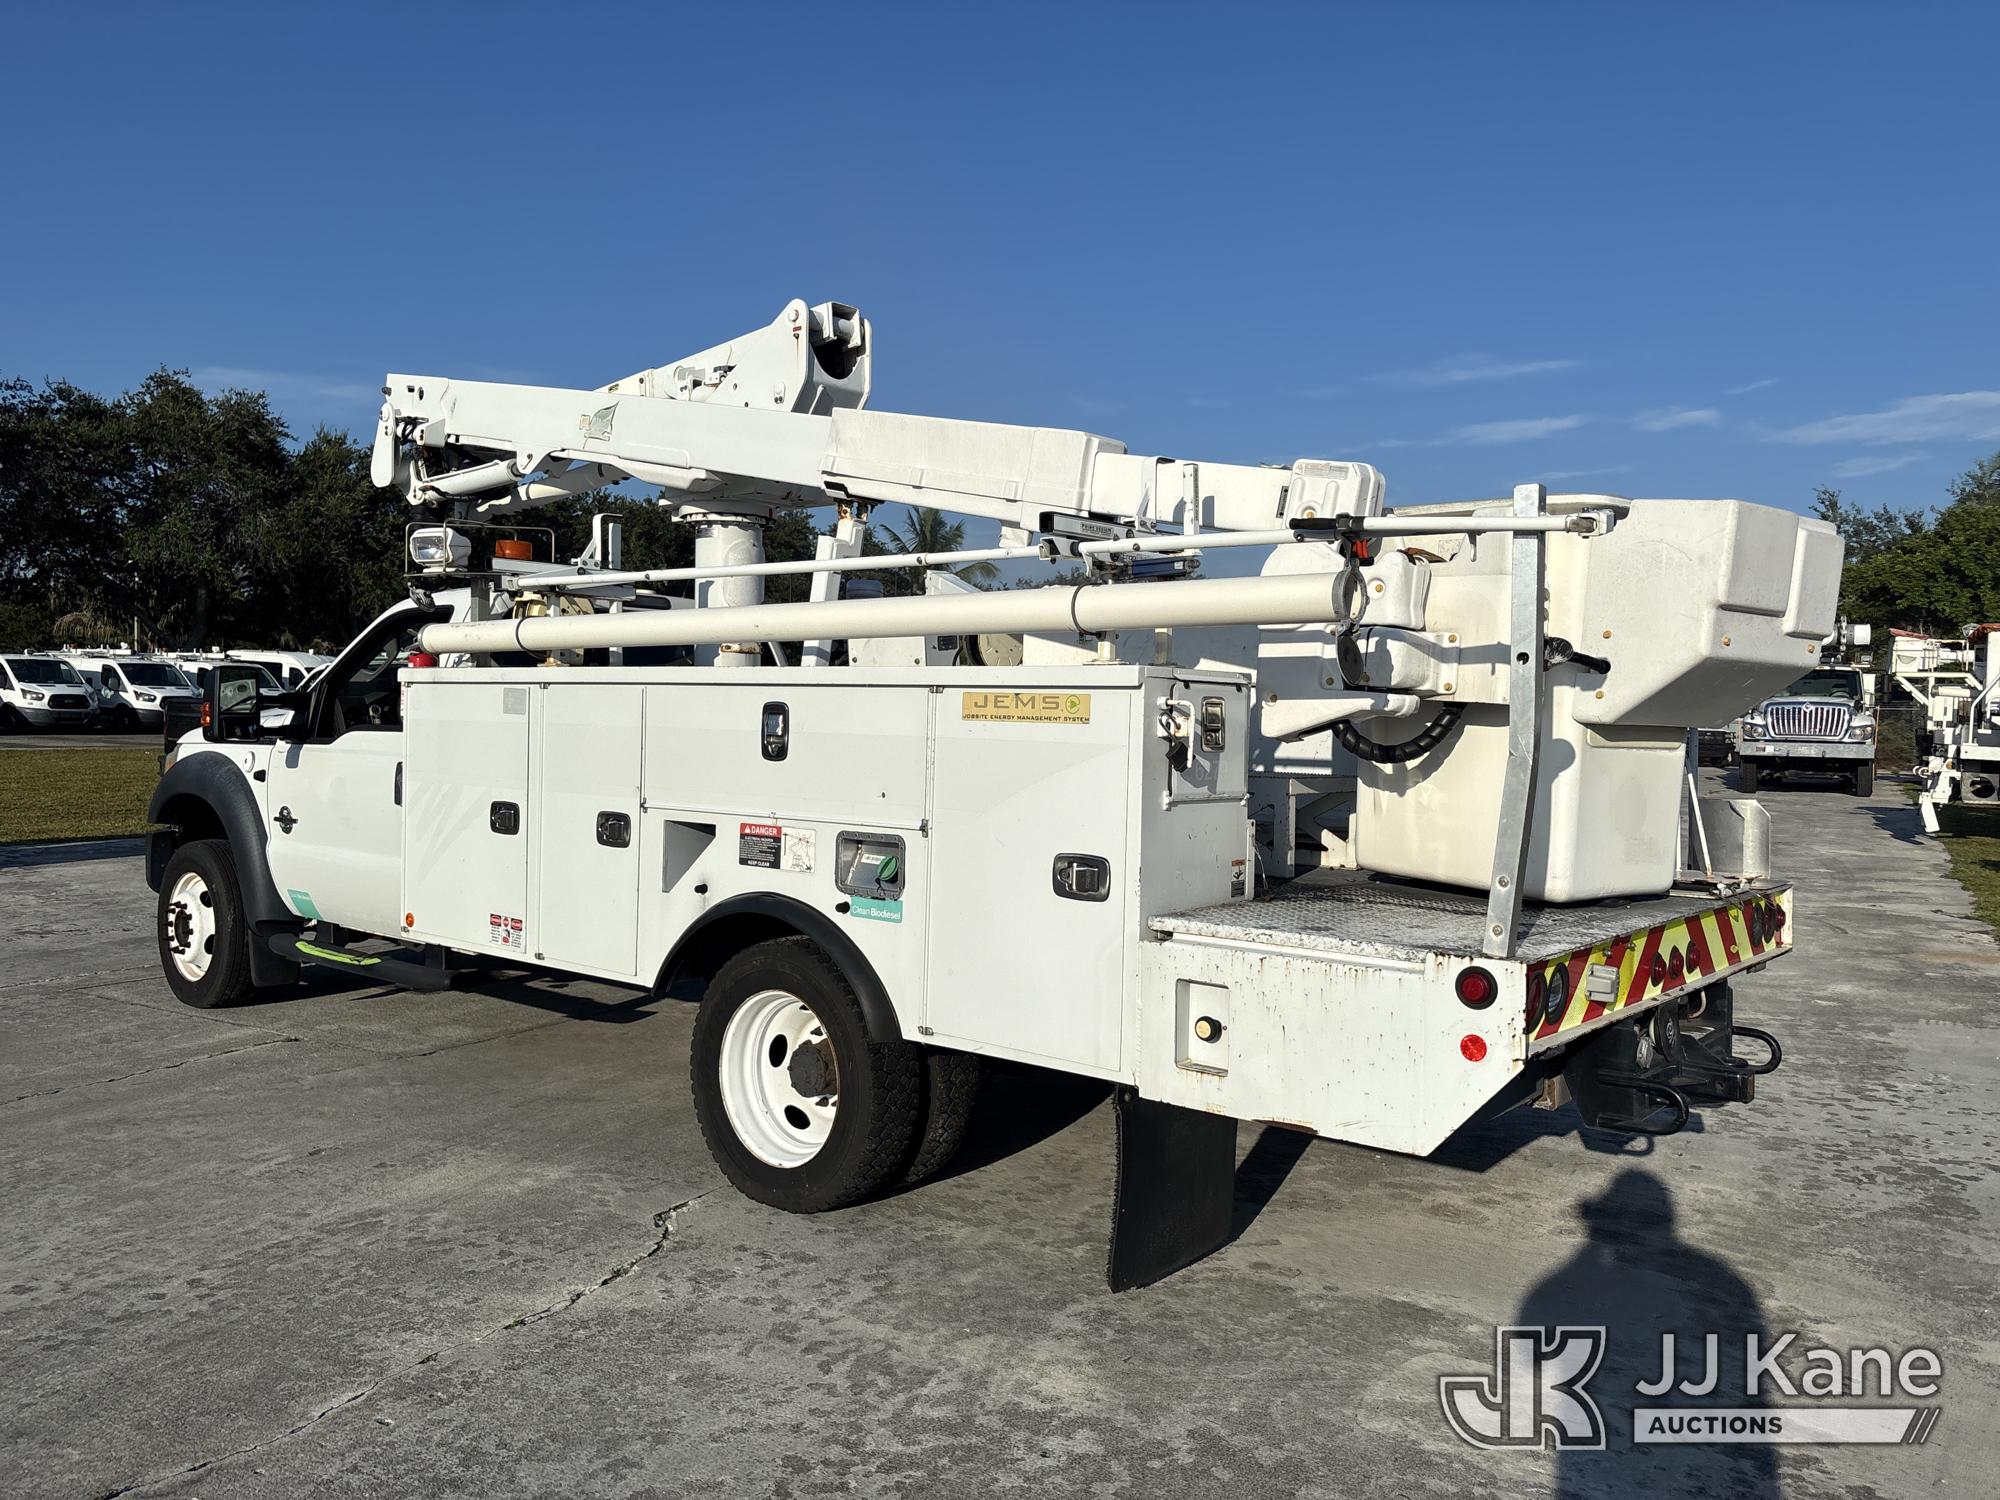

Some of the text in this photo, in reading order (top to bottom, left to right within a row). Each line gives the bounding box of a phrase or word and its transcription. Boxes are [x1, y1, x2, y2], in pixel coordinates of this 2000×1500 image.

[973, 694, 1060, 710] JEMS
[1016, 714, 1062, 722] MANAGEMENT
[751, 826, 777, 836] DANGER
[852, 904, 901, 920] Clean Biodiesel
